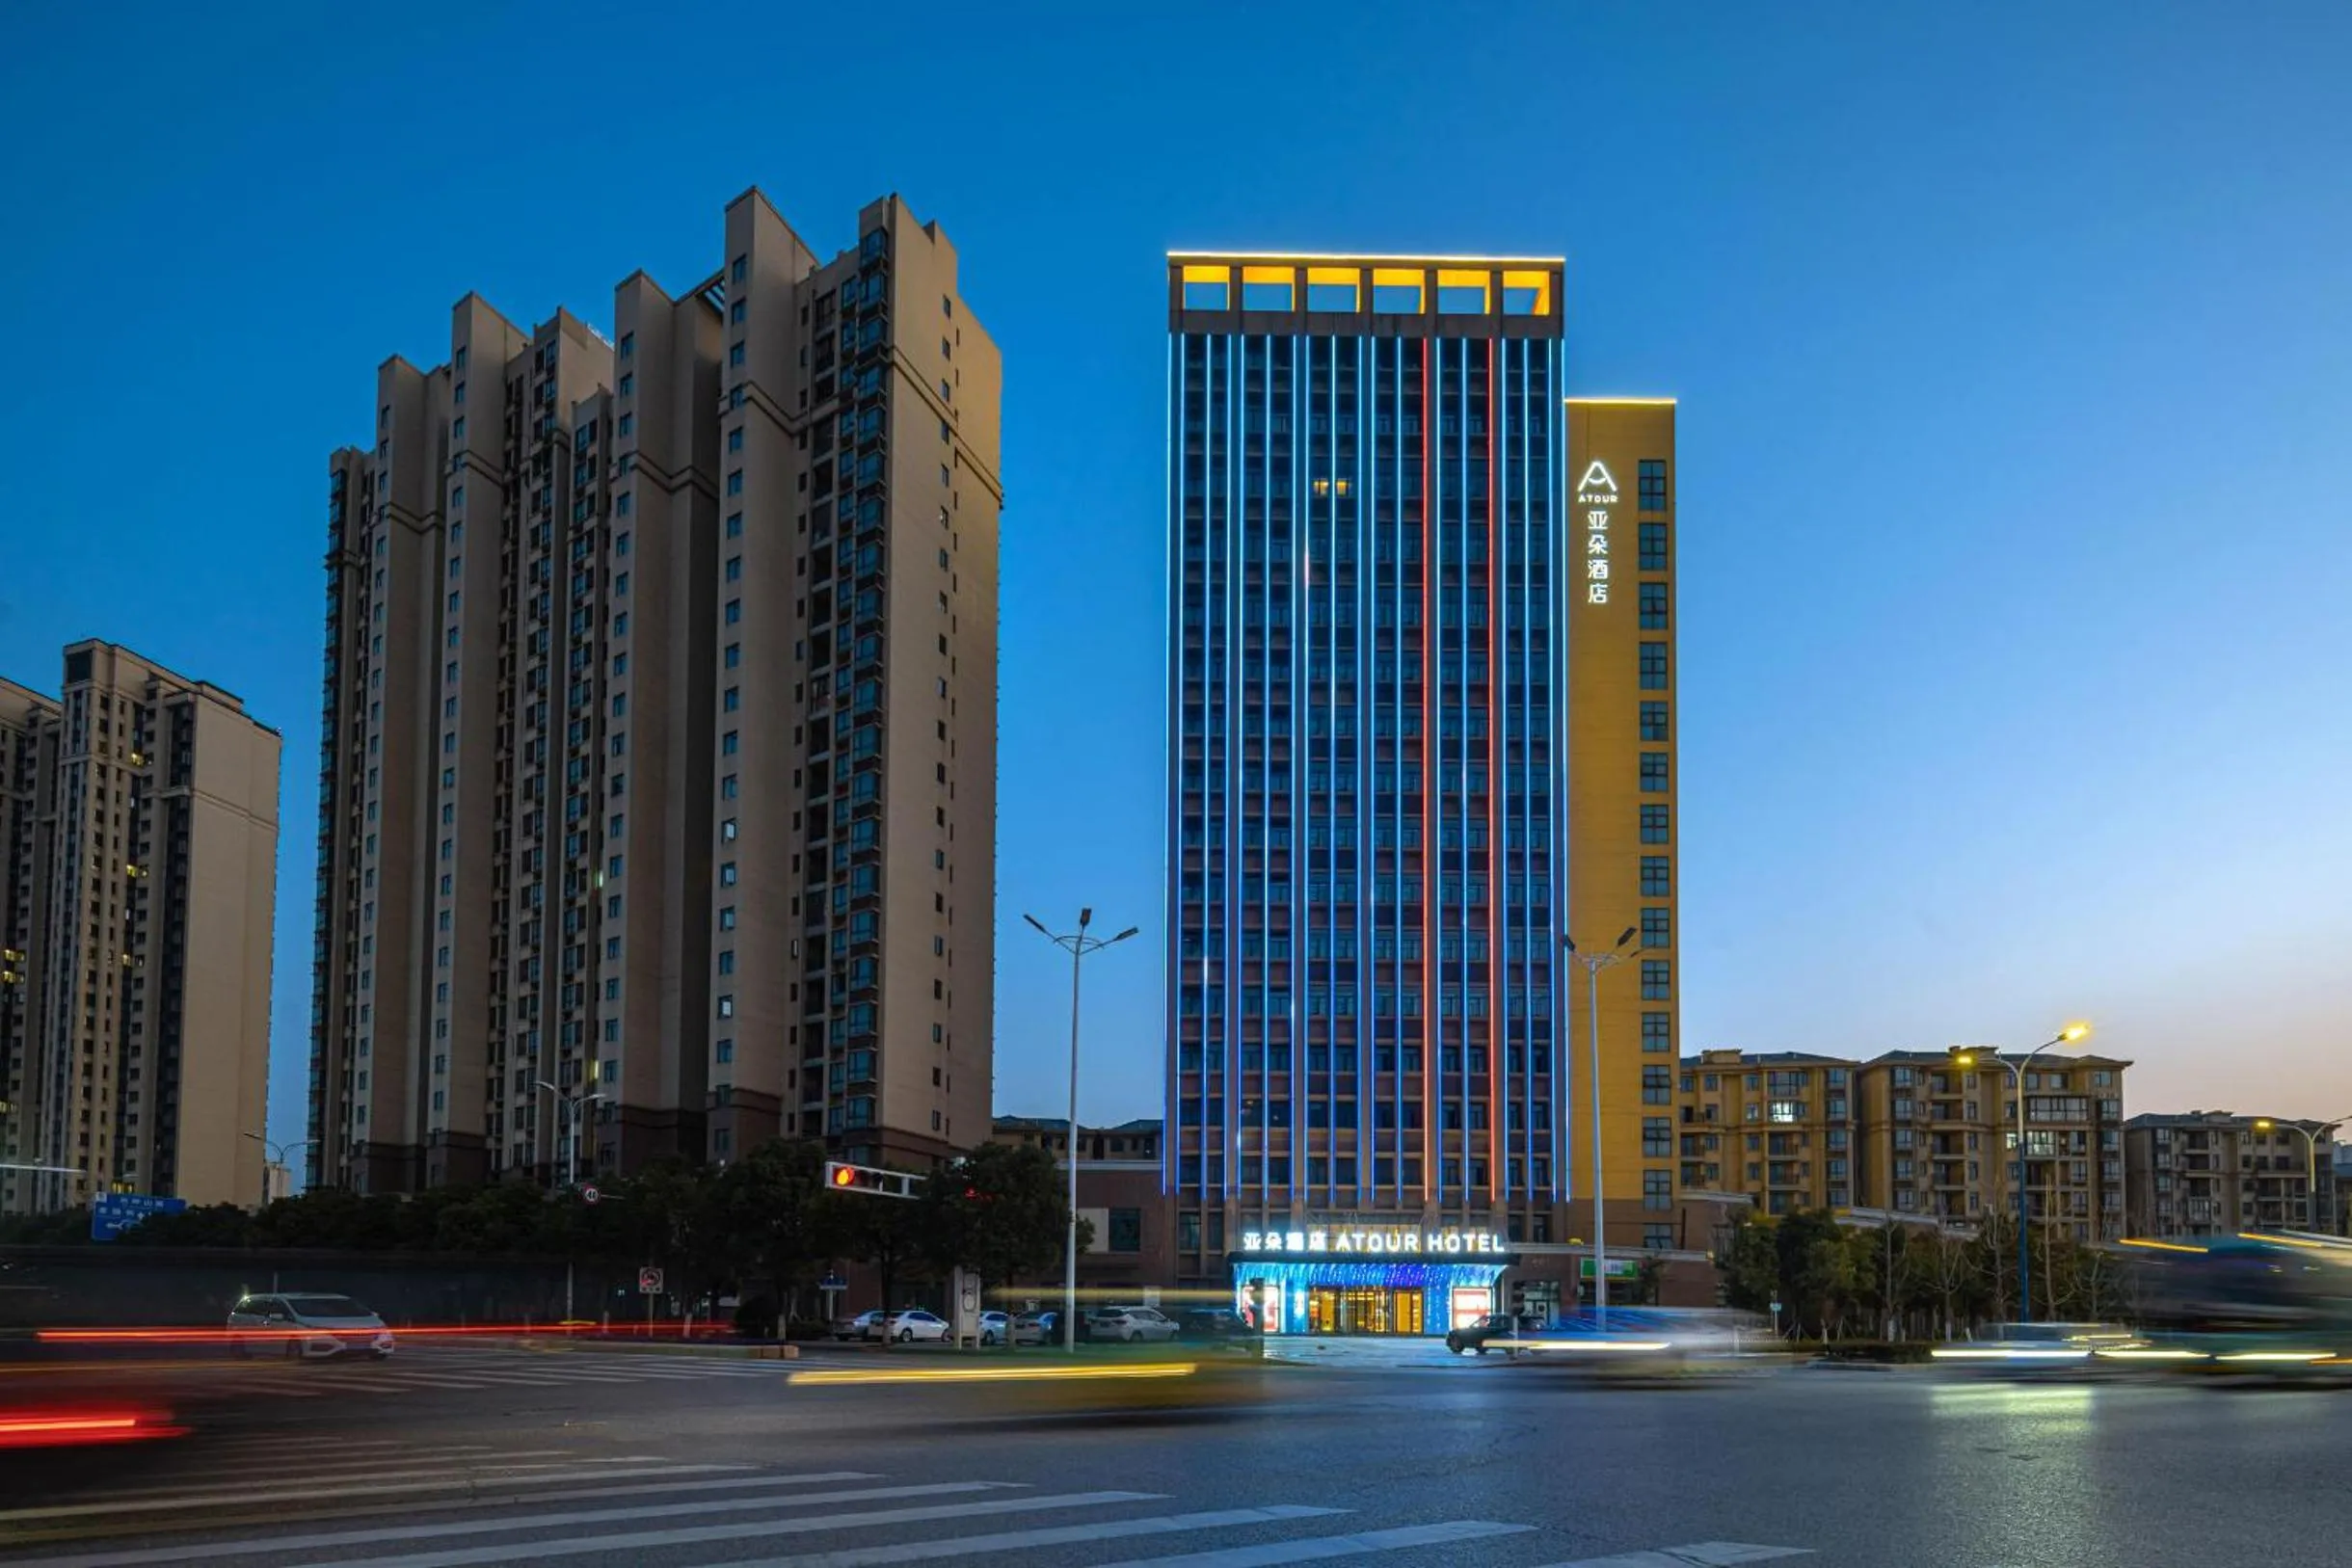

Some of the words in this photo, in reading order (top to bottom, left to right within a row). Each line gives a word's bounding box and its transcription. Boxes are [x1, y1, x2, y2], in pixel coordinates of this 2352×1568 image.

[1578, 494, 1618, 503] ATOUR
[1588, 511, 1609, 603] 亚朵酒店
[1243, 1232, 1327, 1251] 亚朵店
[1335, 1233, 1419, 1252] ATOUR
[1427, 1233, 1505, 1252] HOTEL
